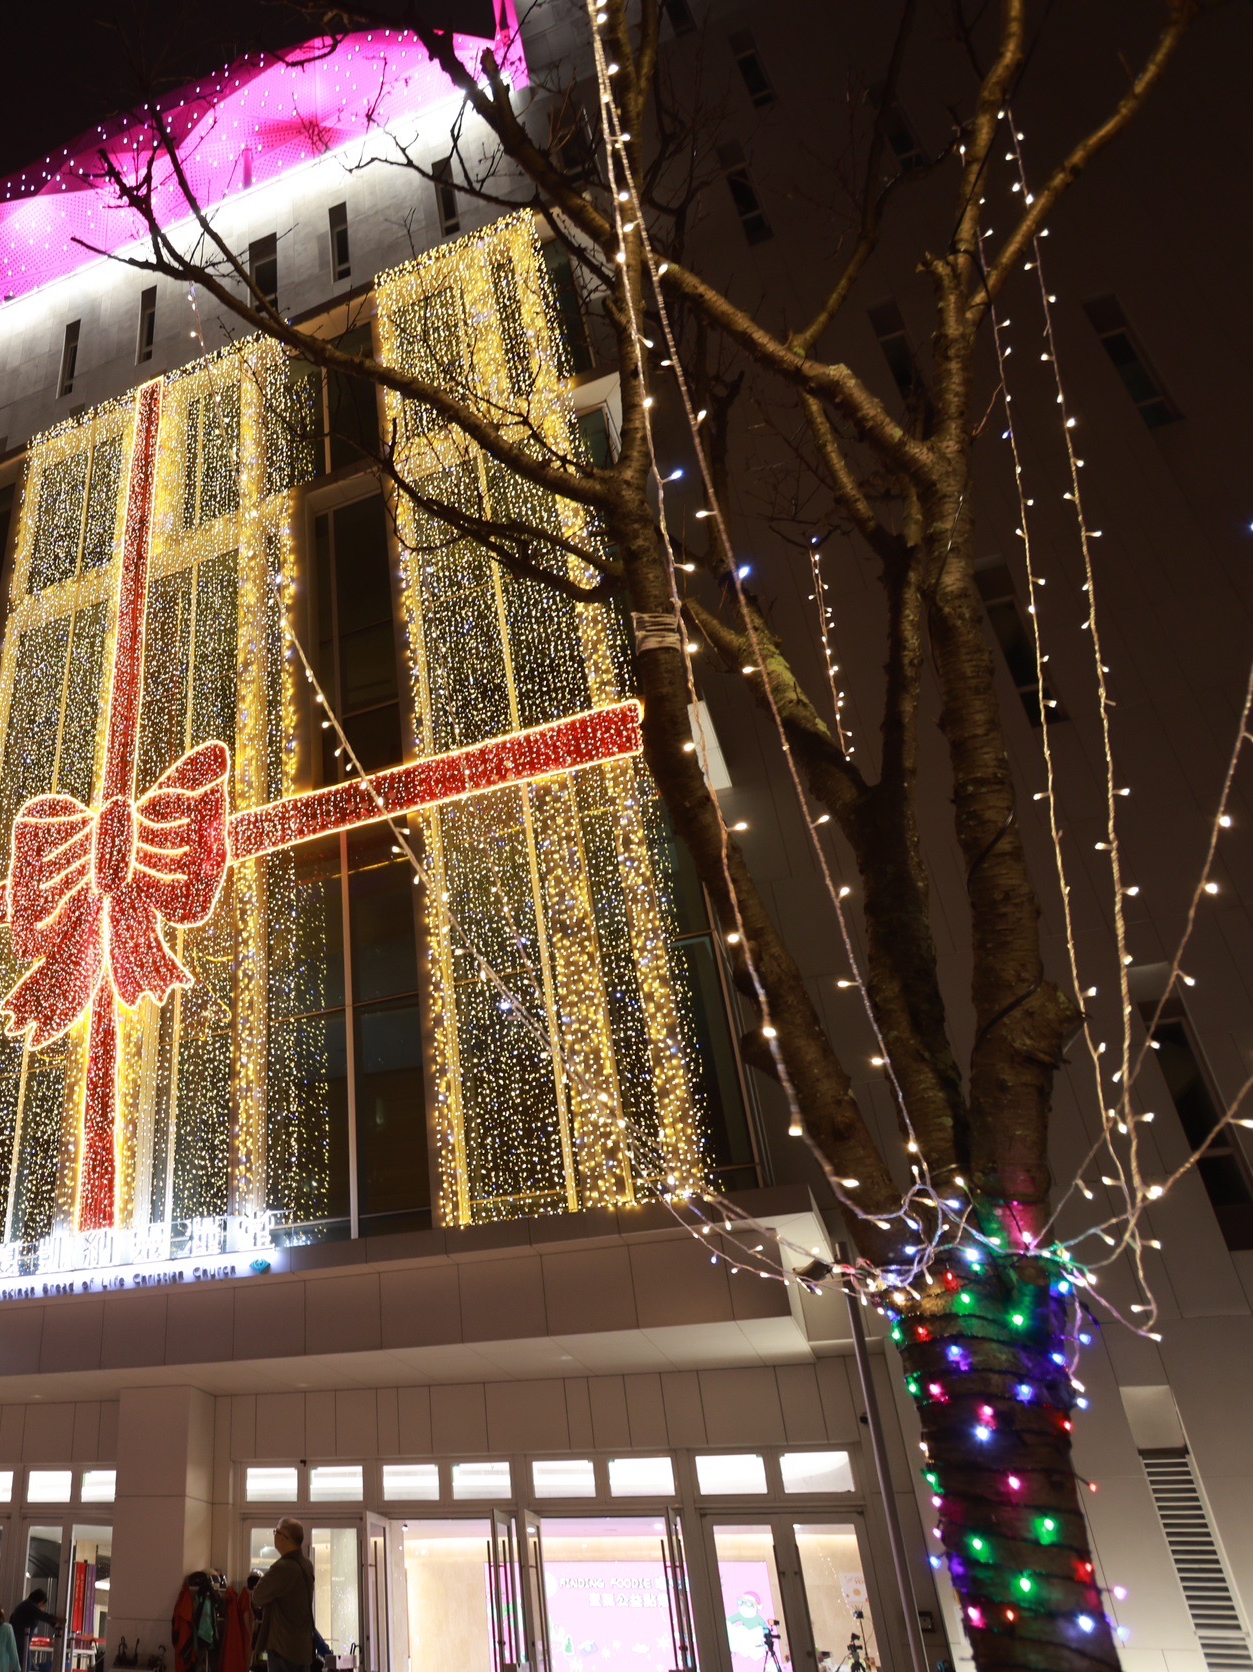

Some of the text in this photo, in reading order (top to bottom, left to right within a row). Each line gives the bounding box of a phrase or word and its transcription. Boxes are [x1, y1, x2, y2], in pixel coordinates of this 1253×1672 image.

[42, 1281, 74, 1296] Bread
[81, 1277, 94, 1291] of
[101, 1275, 125, 1290] Life
[132, 1270, 185, 1286] Christian
[192, 1264, 237, 1280] Church
